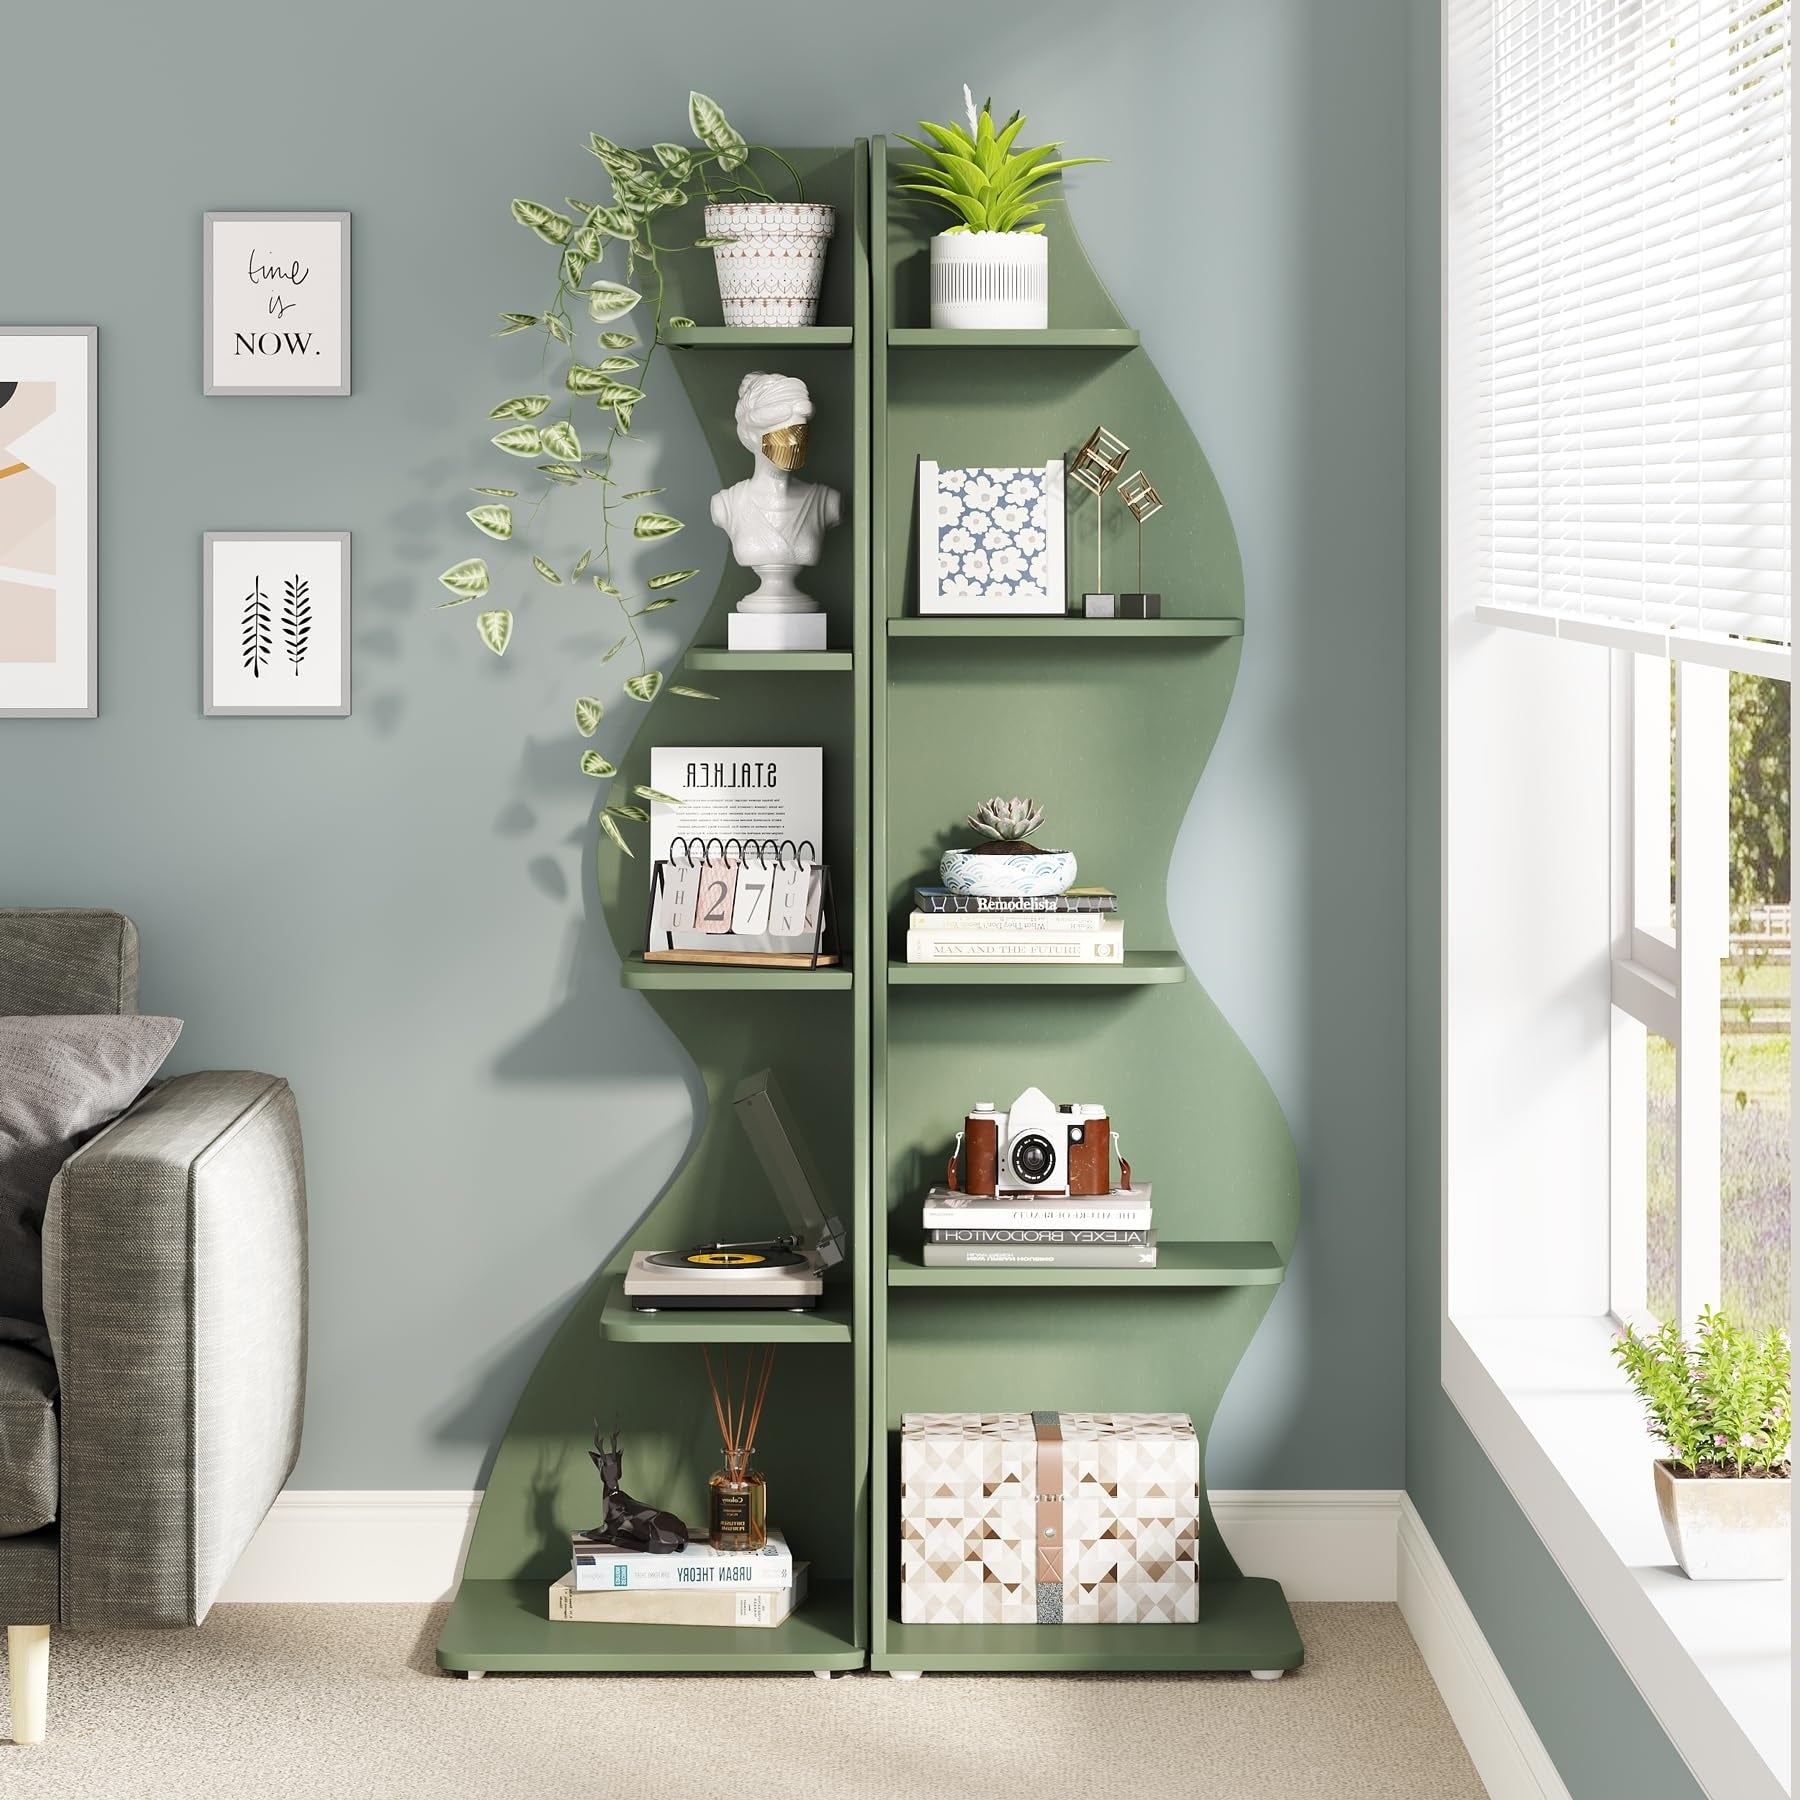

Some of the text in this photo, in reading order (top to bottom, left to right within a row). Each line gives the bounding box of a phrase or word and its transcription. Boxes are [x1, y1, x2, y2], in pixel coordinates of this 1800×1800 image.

[248, 249, 309, 285] time
[269, 289, 297, 319] is
[234, 332, 320, 356] NOW.
[977, 897, 1058, 911] Remodelista
[934, 946, 1081, 954] MAN AND THE FUTURE
